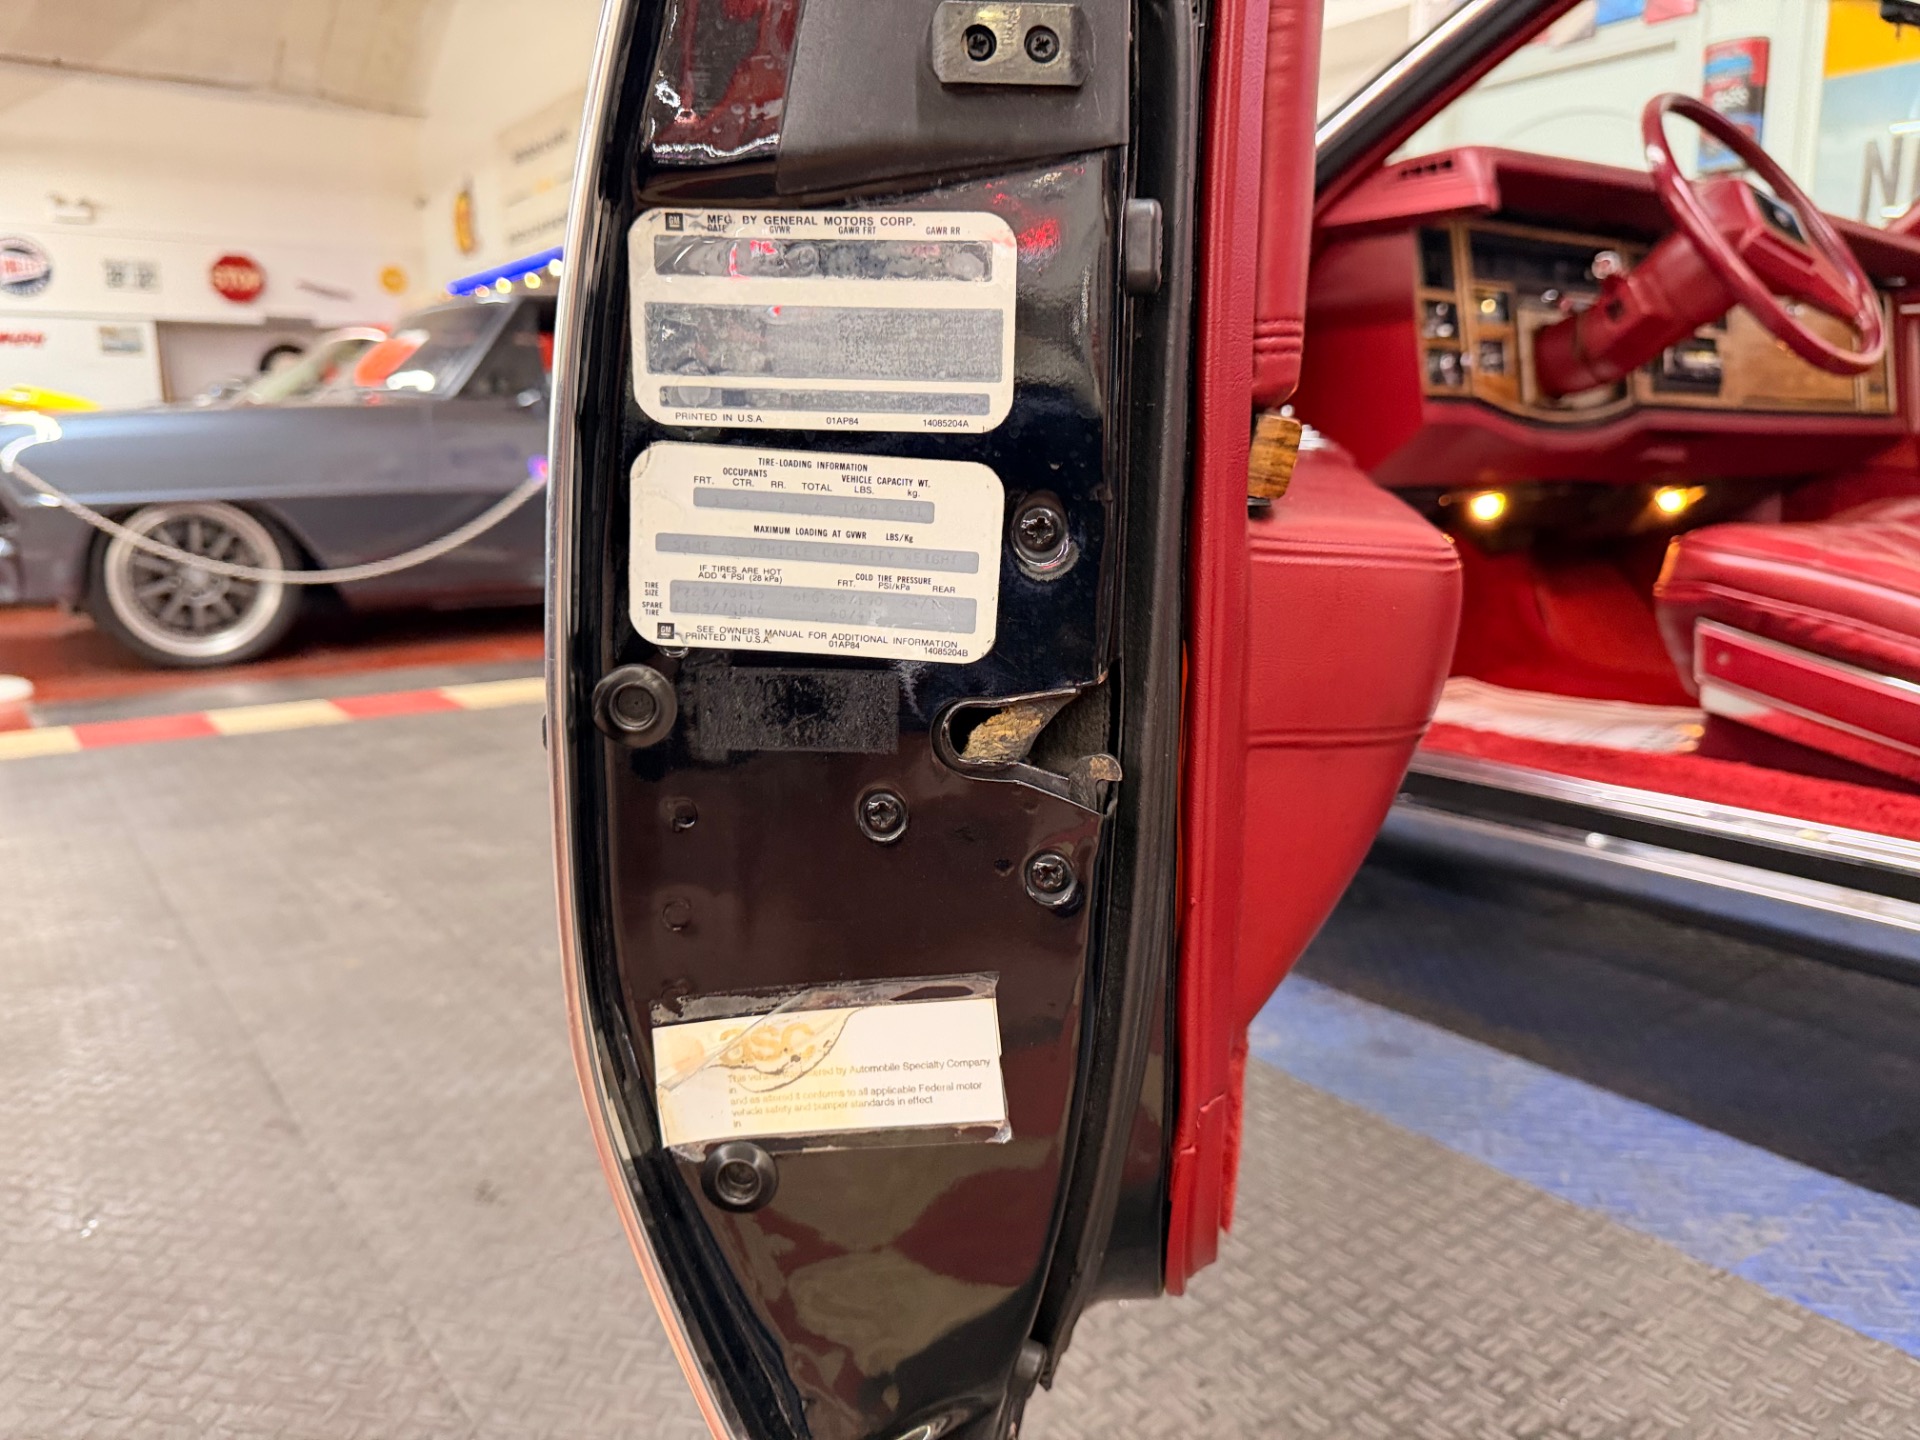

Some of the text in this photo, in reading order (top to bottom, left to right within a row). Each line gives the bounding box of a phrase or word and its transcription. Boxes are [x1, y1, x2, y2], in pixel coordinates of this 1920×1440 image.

[707, 215, 916, 227] MFG. BY GENERAL MOTORS CORP.
[769, 226, 791, 234] GVWR
[838, 226, 876, 235] GAWR FRT
[926, 227, 948, 235] GAWR
[675, 412, 765, 423] PRINTED IN U.S.A.
[826, 417, 859, 426] 01AP84
[923, 420, 969, 428] 14085204A
[758, 458, 868, 472] TIRE-LOADING INFORMATION
[723, 468, 768, 478] OCCUPANTS
[694, 476, 920, 498] FRT. CTR. RR. TOTAL LBS. kg.
[842, 475, 931, 488] VEHICLE CAPACITY WT.
[754, 525, 914, 543] MAXIMUM LOADING AT GVWR LBS/Kg
[742, 566, 758, 574] ARE
[763, 568, 782, 576] HOT
[698, 571, 717, 579] ADD
[731, 573, 744, 581] PSI
[749, 573, 763, 582] (28
[764, 574, 783, 584] kPa)
[855, 573, 932, 585] COLD TIRE PRESSURE
[838, 579, 956, 594] FRT. PSI/kPa REAR
[645, 589, 659, 597] SIZE
[642, 601, 663, 609] SPARE
[686, 632, 771, 644] PRINTED IN U.S.A.
[696, 625, 958, 649] SEE OWNERS MANUAL FOR ADDITIONAL INFORMATION
[828, 640, 860, 650] 01AP84
[924, 647, 968, 657] 14085204B
[836, 1066, 847, 1077] by
[850, 1063, 900, 1075] Automobile
[903, 1060, 944, 1072] Specialty
[947, 1058, 991, 1070] Company
[871, 1084, 916, 1097] applicable
[919, 1083, 954, 1093] Federal
[956, 1082, 982, 1091] motor
[850, 1096, 895, 1108] standards
[898, 1096, 906, 1106] in
[908, 1095, 933, 1105] effect
